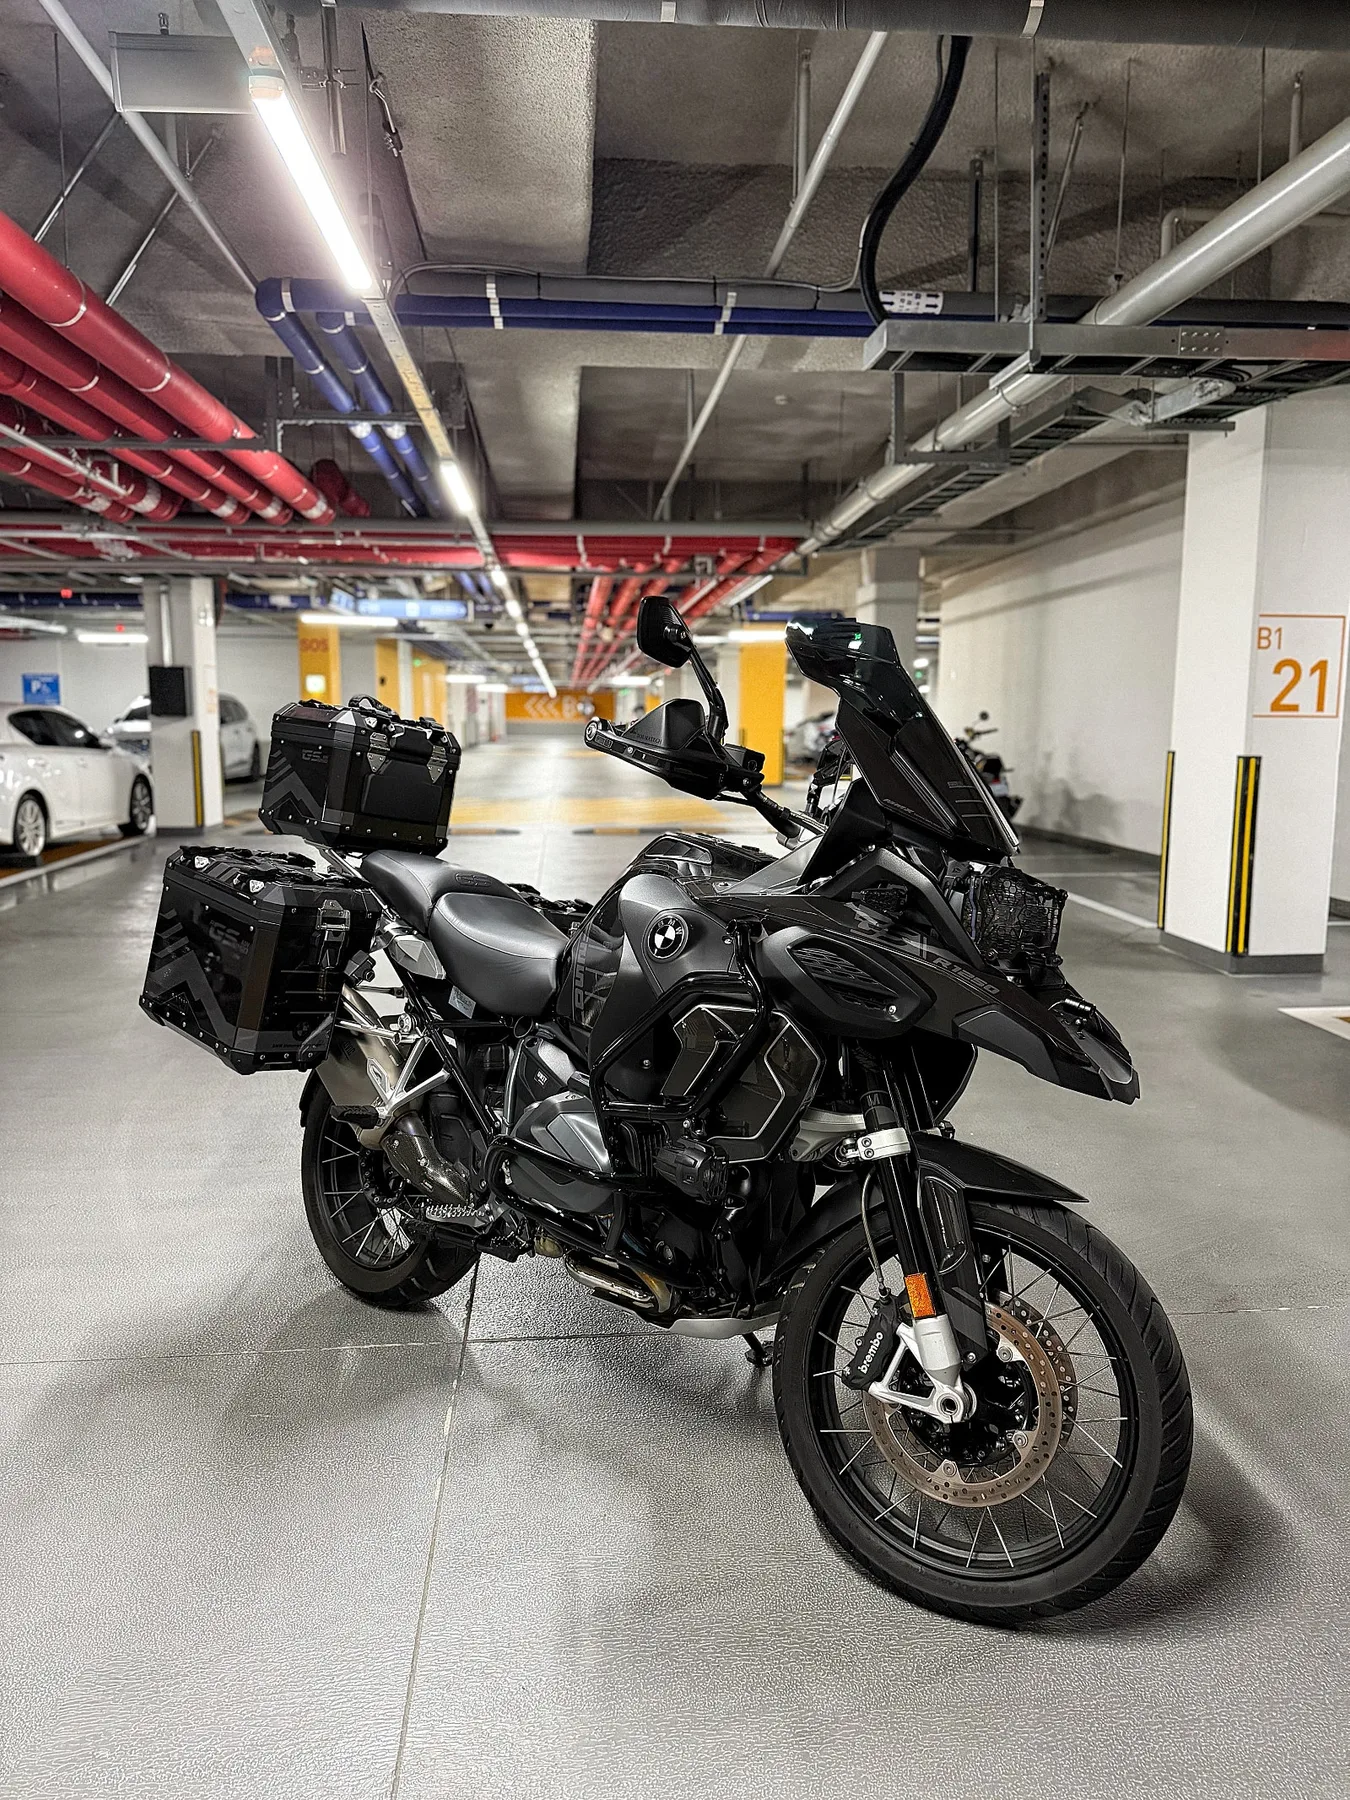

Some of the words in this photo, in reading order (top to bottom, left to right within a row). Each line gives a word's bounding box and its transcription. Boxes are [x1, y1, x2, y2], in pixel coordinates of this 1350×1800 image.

[301, 638, 328, 652] SOS
[1257, 626, 1282, 650] B1
[1270, 658, 1328, 712] 21
[858, 1331, 884, 1374] brembo
